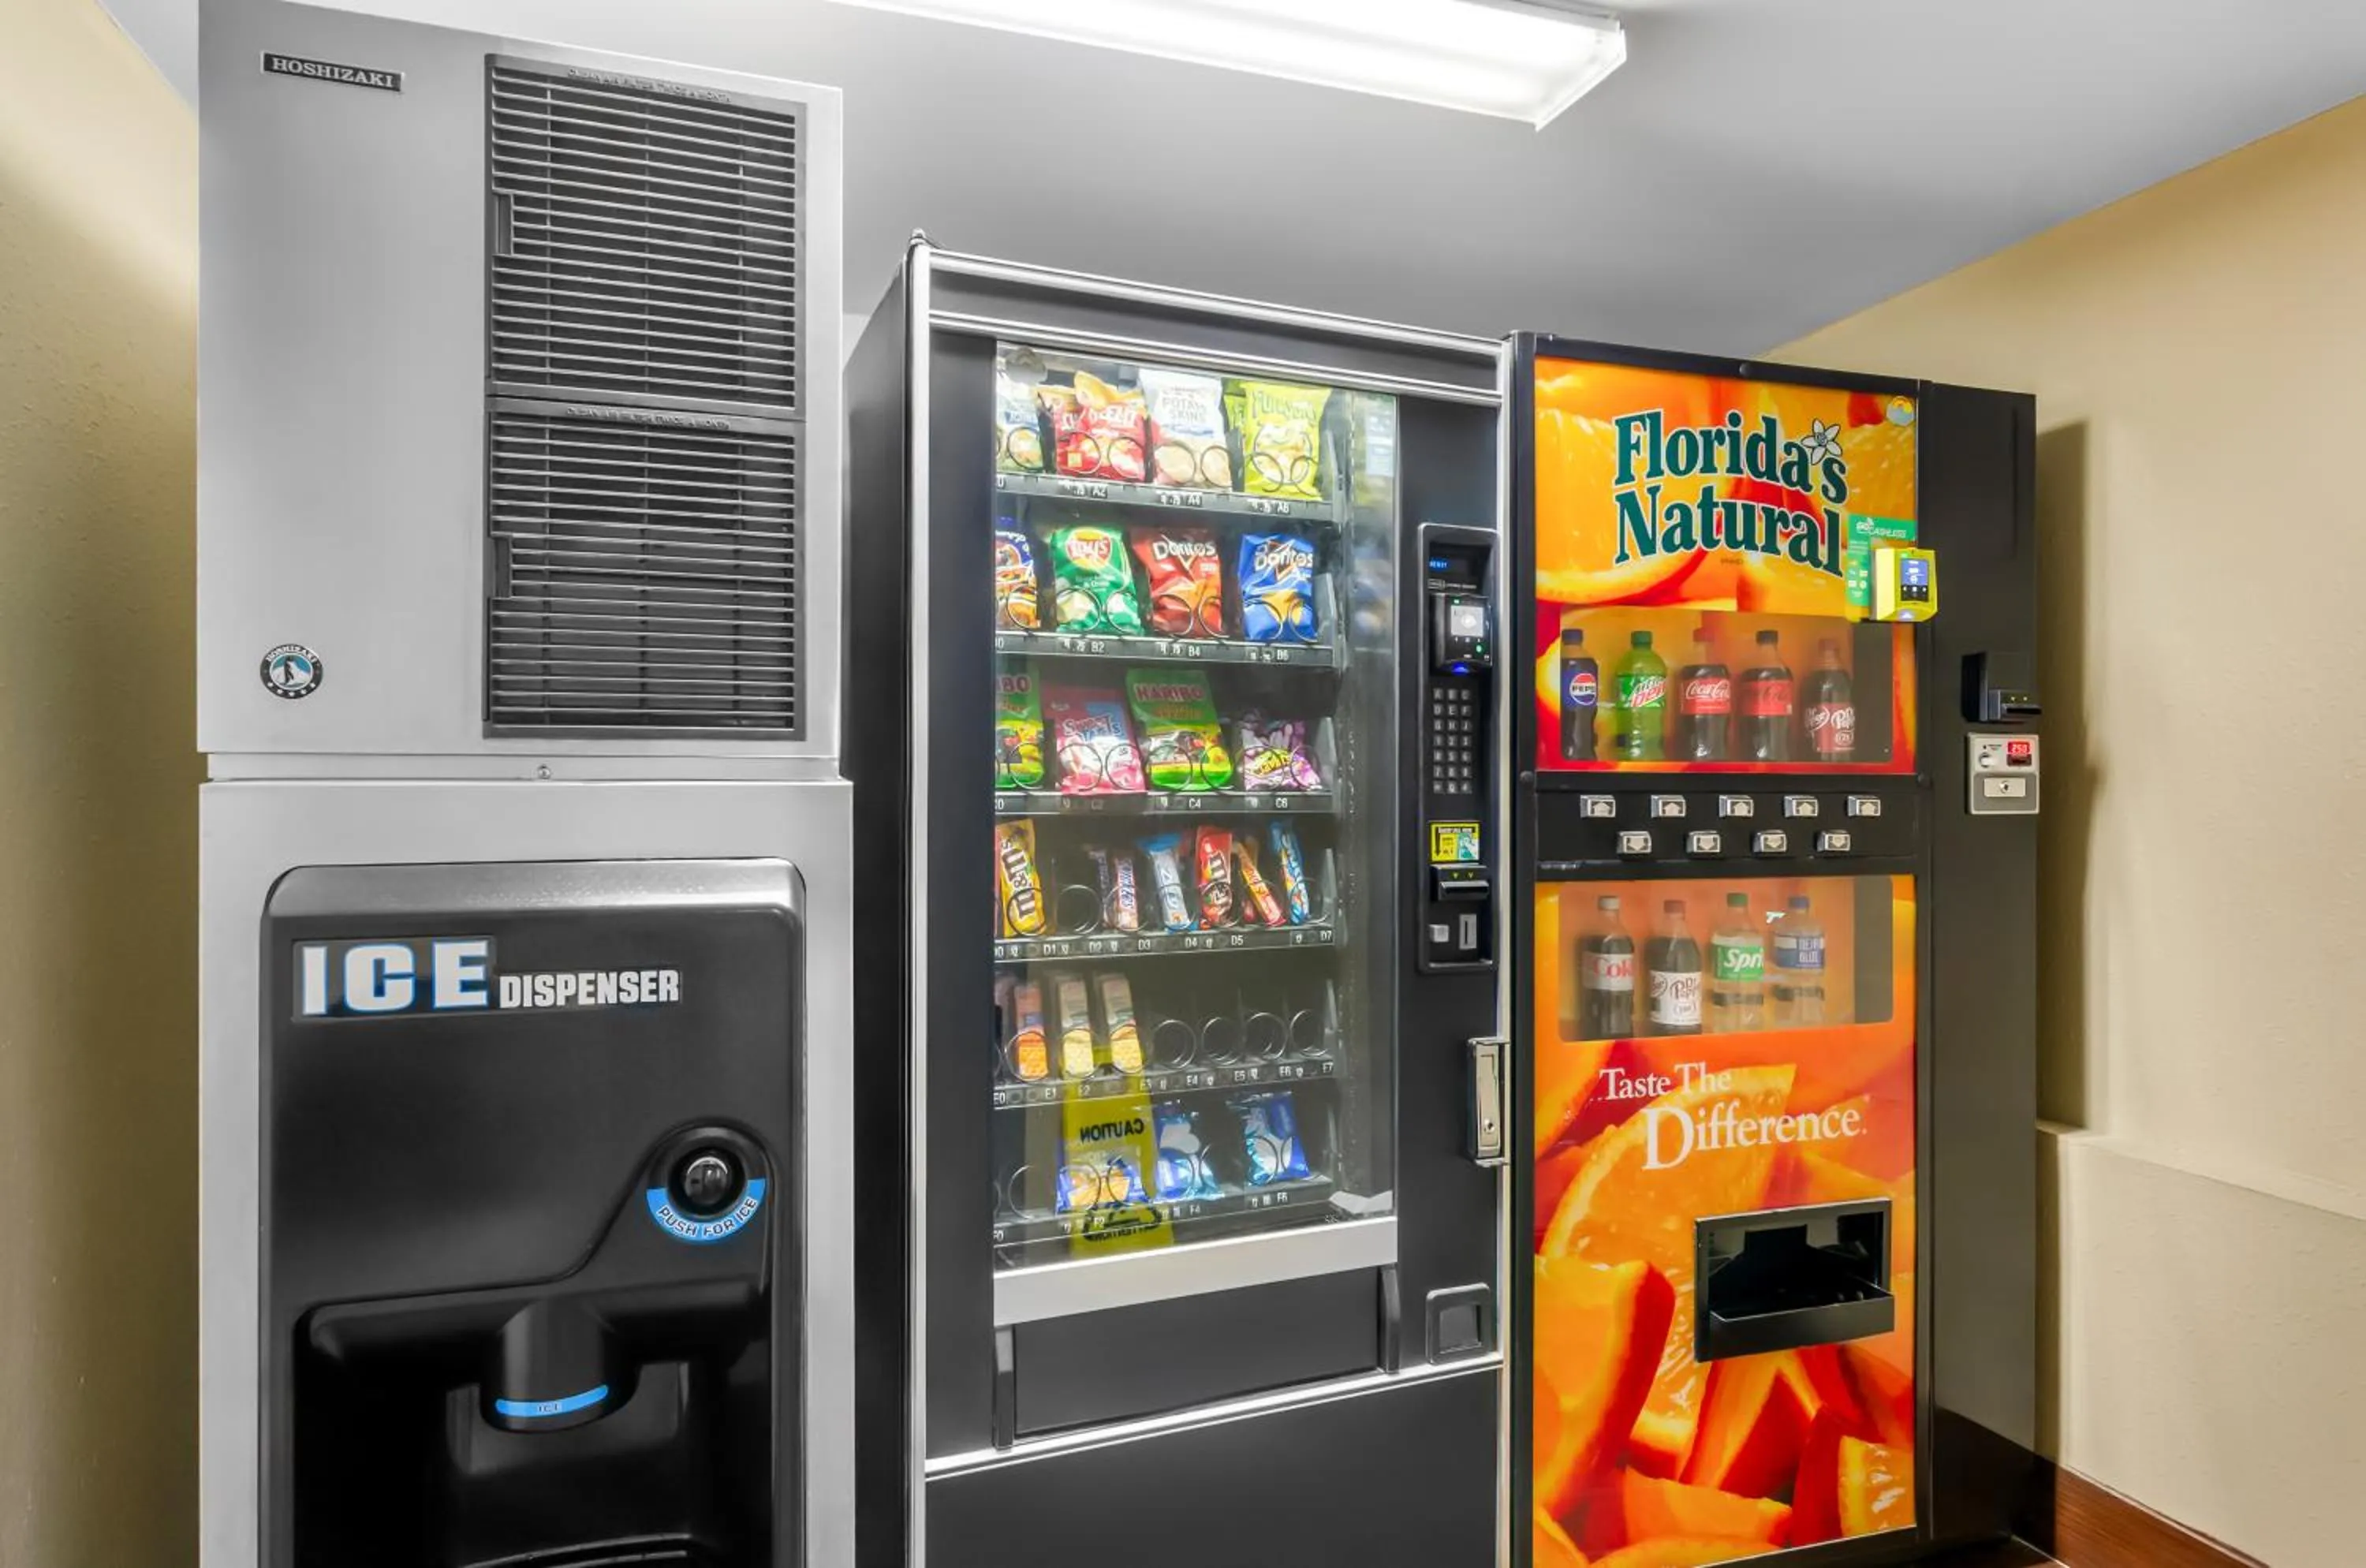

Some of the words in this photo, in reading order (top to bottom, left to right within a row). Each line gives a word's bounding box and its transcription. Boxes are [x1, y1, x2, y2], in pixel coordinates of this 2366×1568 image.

[272, 58, 394, 88] HOSHIZAKI
[1614, 484, 1844, 578] Natural
[1152, 540, 1216, 560] Doritos
[1255, 548, 1313, 571] Doritos
[1135, 683, 1205, 702] HARIBO
[1189, 799, 1201, 809] C4
[1043, 943, 1056, 954] D1
[1089, 941, 1102, 952] D2
[1185, 936, 1197, 947] D4
[1231, 935, 1244, 946] D5
[1320, 931, 1332, 941] D7
[302, 940, 488, 1015] ICE
[499, 969, 681, 1009] DISPENSER
[1674, 1061, 1732, 1094] The
[1045, 1088, 1056, 1099] E1
[658, 1204, 697, 1236] PUSH
[703, 1219, 735, 1237] FOR
[735, 1196, 757, 1222] ICE
